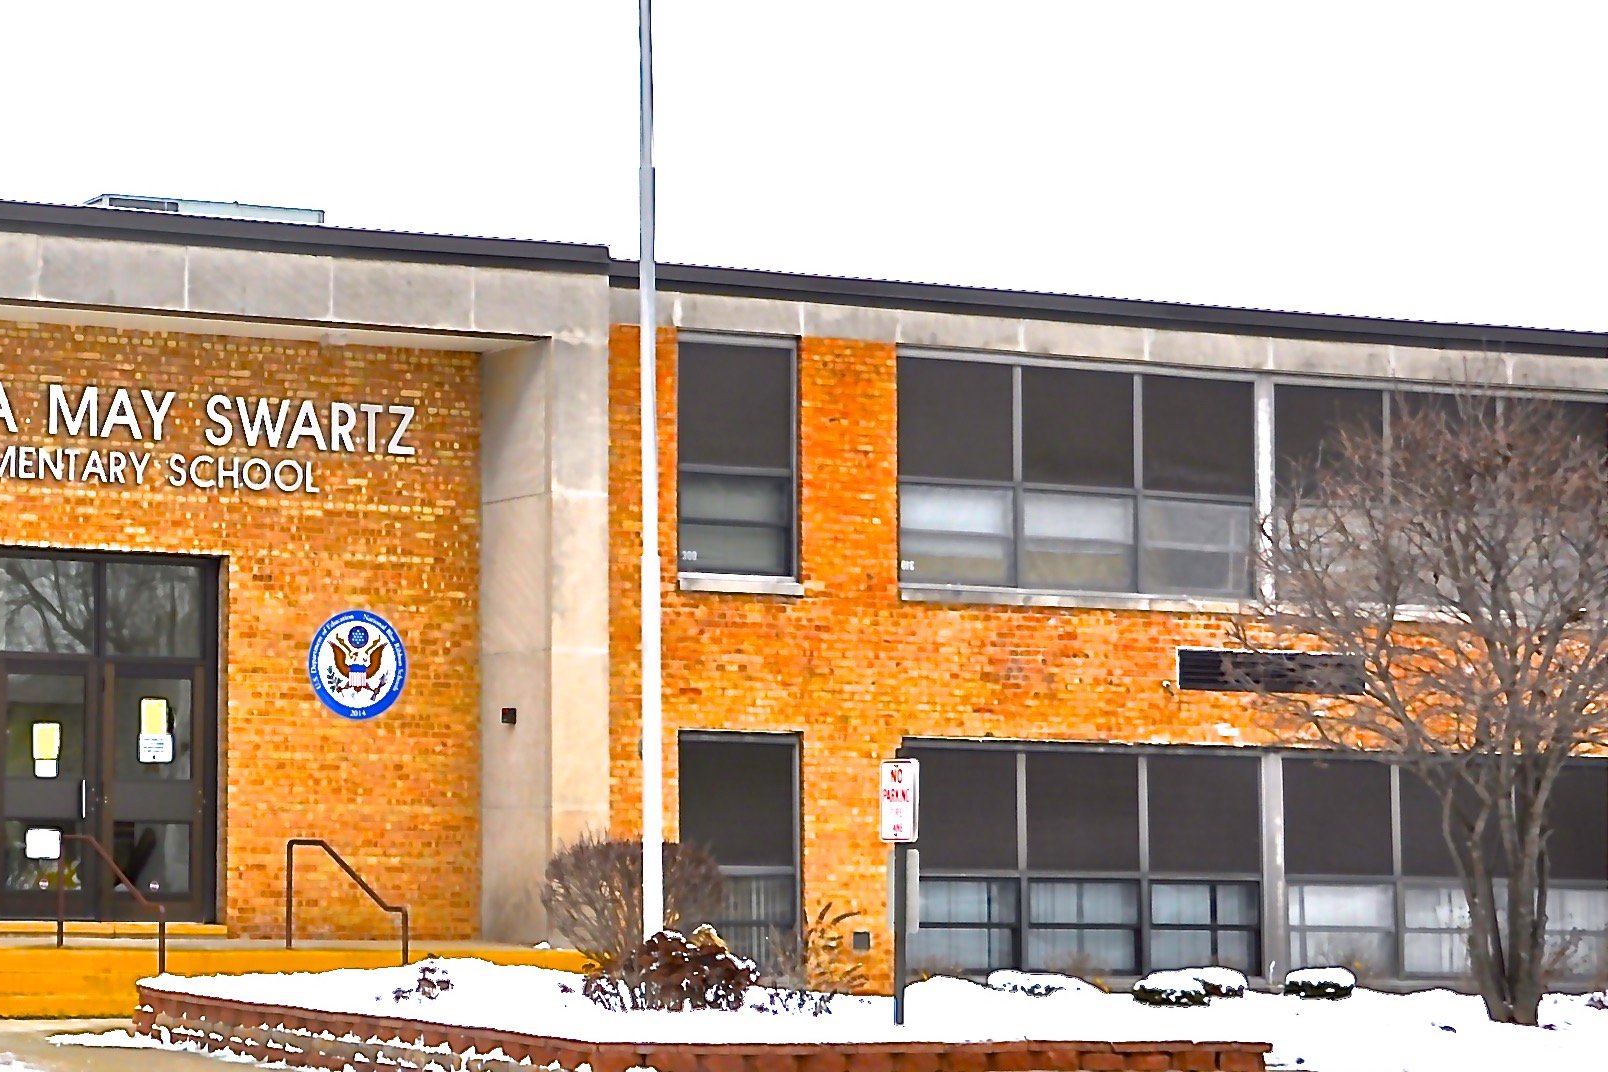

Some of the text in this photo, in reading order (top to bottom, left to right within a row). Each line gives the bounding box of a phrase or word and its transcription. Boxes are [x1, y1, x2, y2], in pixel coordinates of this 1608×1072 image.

[48, 384, 176, 441] MAY
[205, 394, 415, 455] SWARTZ
[169, 453, 320, 493] SCHOOL
[350, 709, 366, 717] 2014
[890, 769, 902, 783] NO
